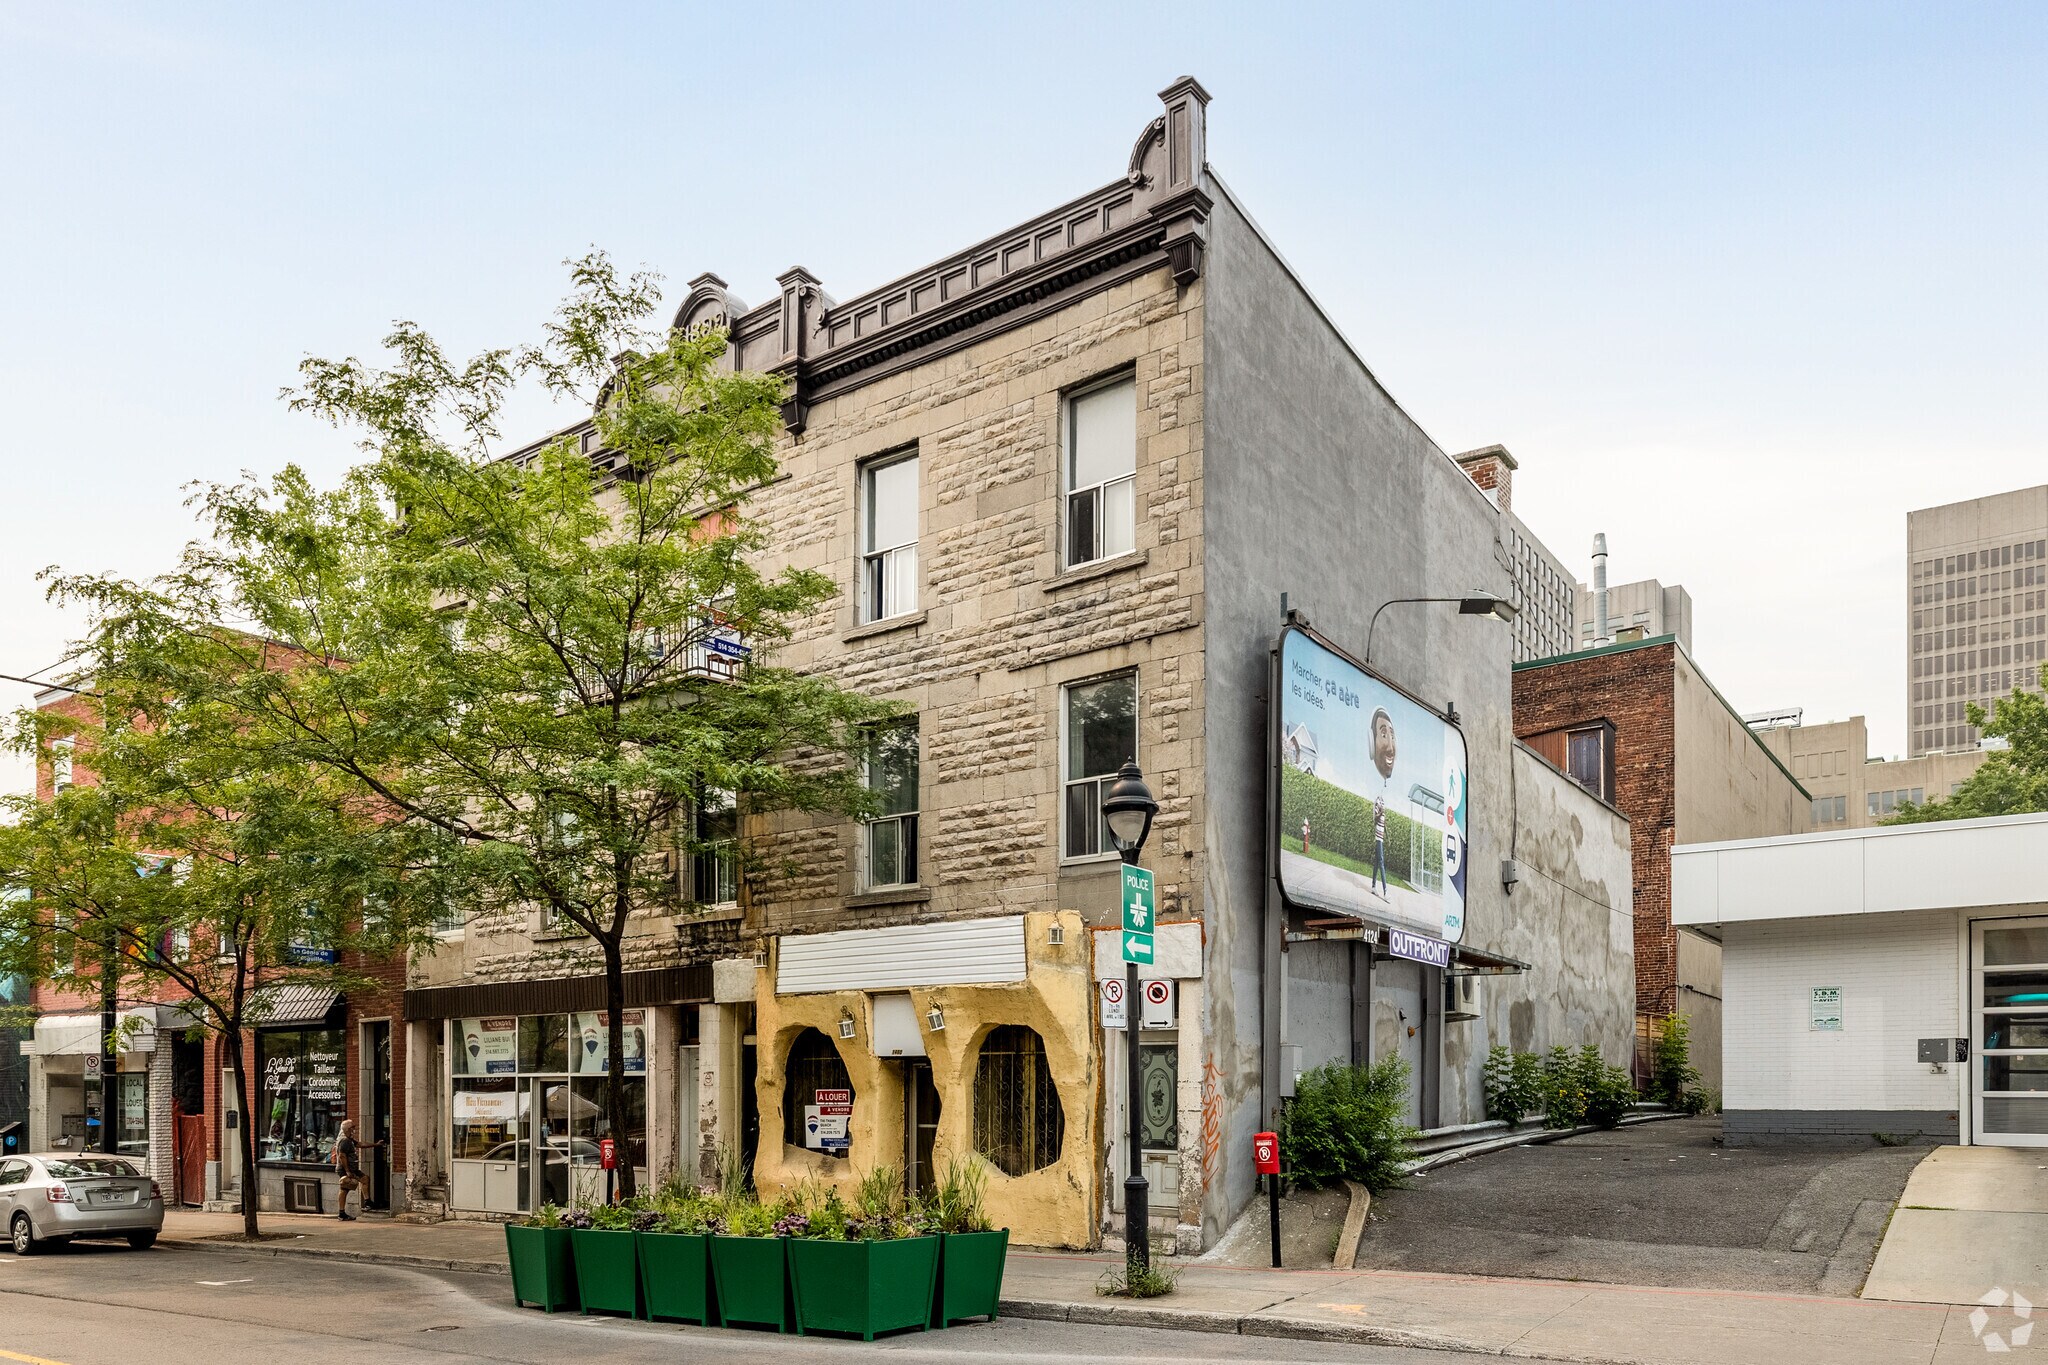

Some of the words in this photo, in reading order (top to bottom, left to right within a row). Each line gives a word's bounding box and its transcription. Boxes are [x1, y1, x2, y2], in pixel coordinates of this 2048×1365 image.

[717, 642, 728, 651] 514
[1292, 659, 1322, 690] Marcher,
[1326, 680, 1336, 698] ça
[1338, 686, 1360, 709] aère
[1292, 680, 1302, 698] les
[1304, 686, 1326, 710] idées.
[1126, 875, 1150, 891] POLICE
[1364, 928, 1378, 944] 4124
[1392, 932, 1447, 964] OUTFRONT
[310, 1052, 338, 1062] Nettoyeur
[264, 1058, 276, 1073] Le
[314, 1064, 336, 1074] Tailleur
[308, 1077, 341, 1087] Cordonnier
[308, 1090, 341, 1099] Accessoires
[819, 1092, 824, 1101] À
